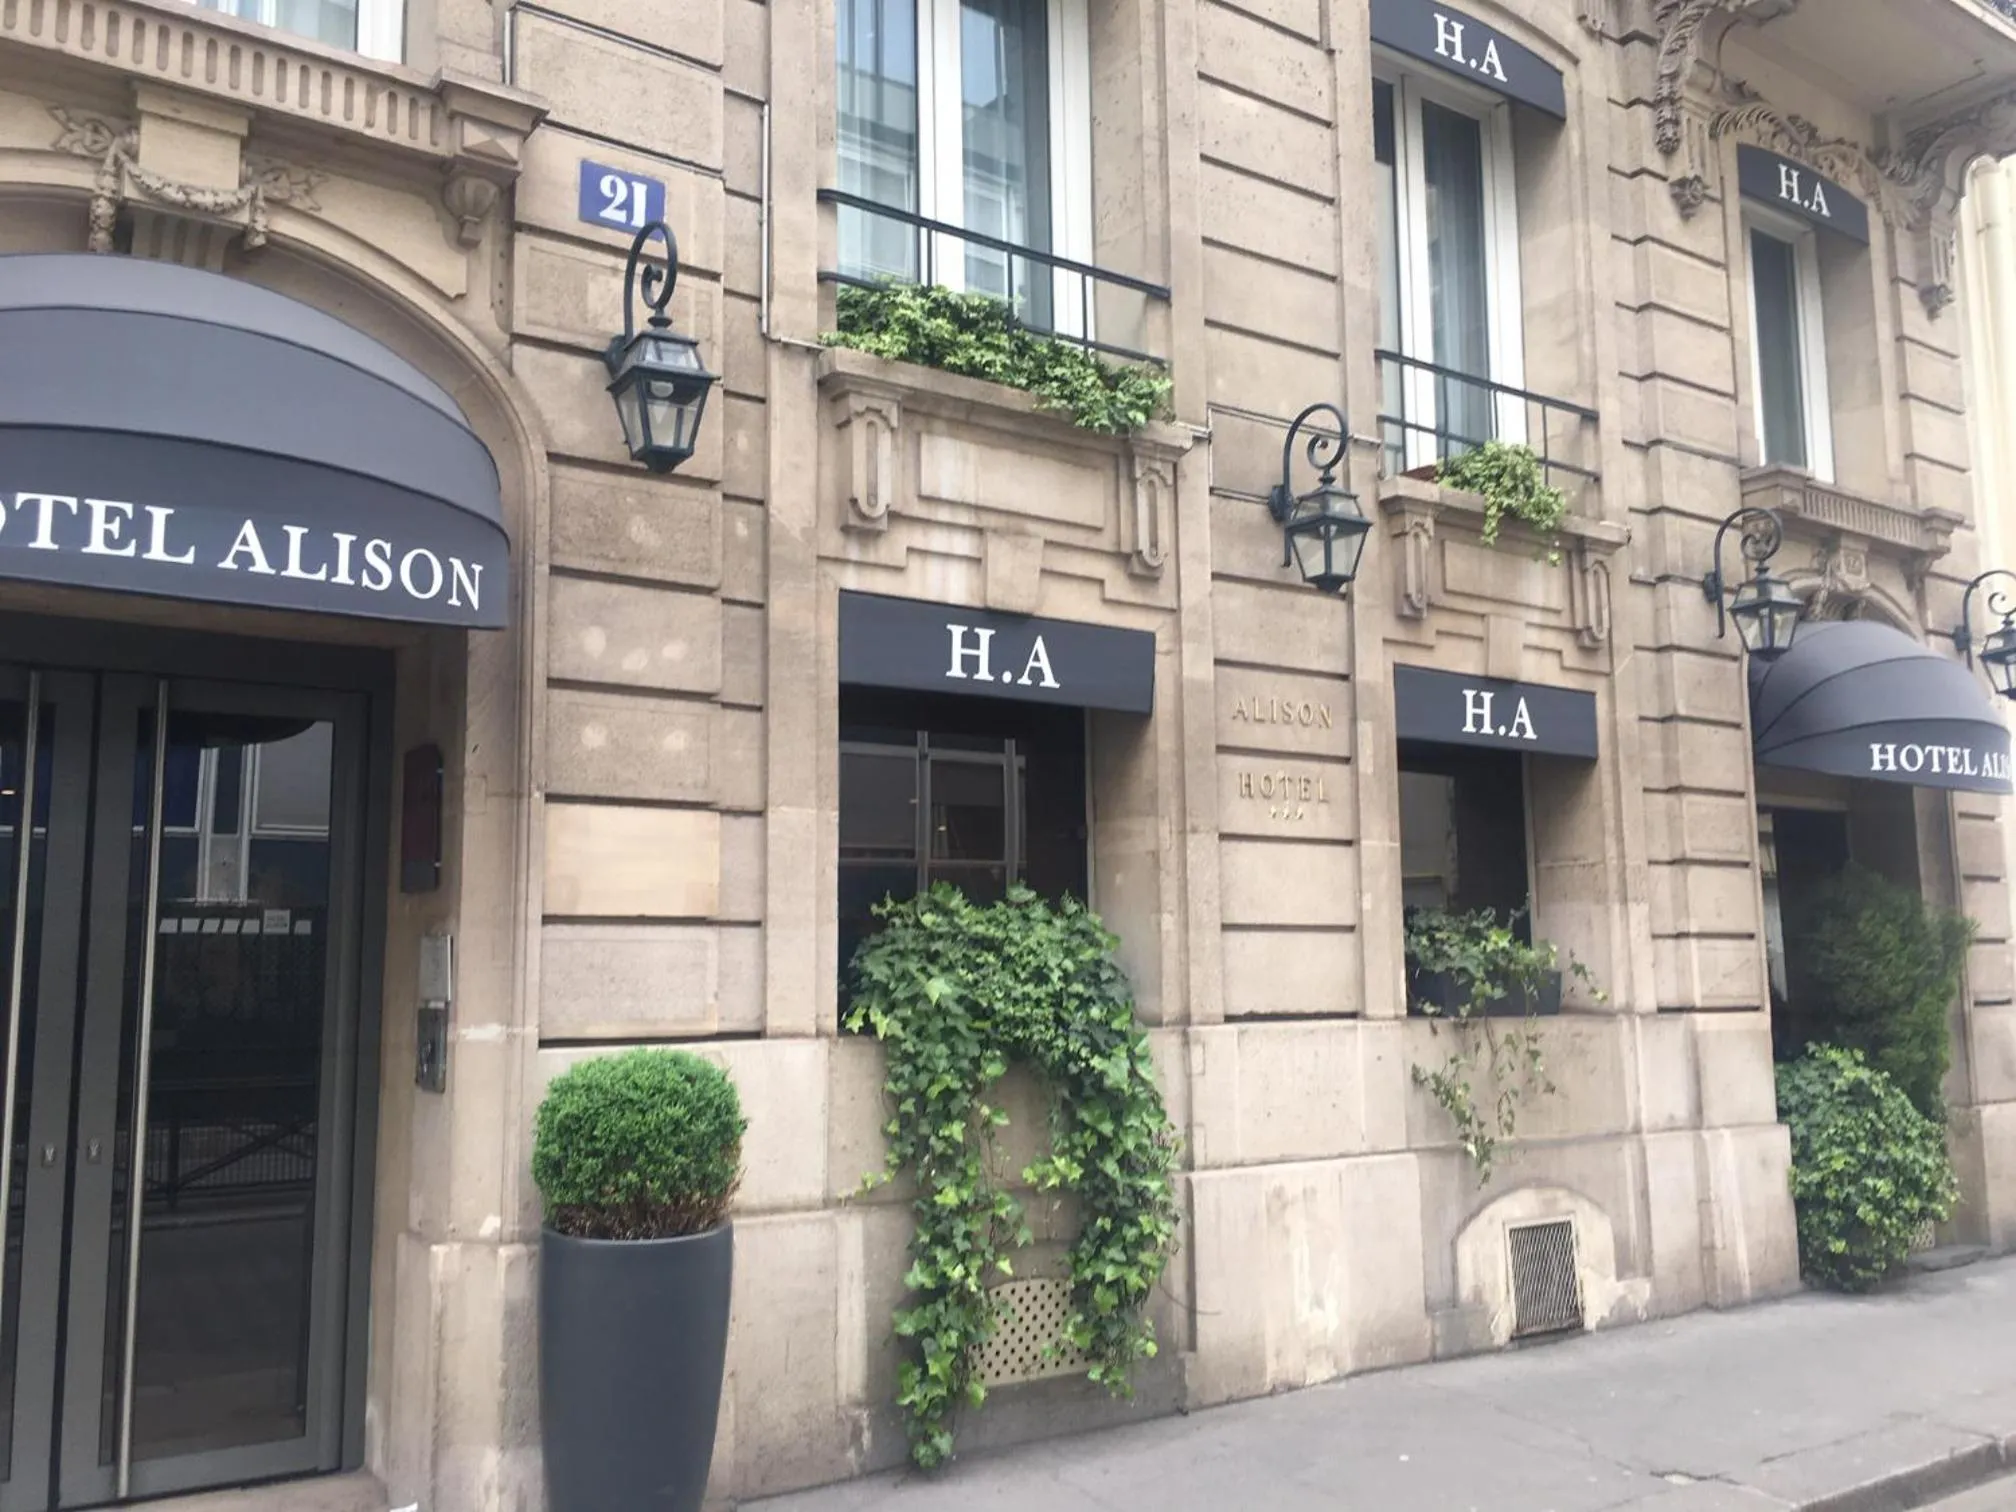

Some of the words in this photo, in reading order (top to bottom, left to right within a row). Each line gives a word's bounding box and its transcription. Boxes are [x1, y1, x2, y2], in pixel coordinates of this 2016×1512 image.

[1433, 12, 1508, 83] H.A
[599, 173, 648, 228] 21
[1778, 163, 1831, 218] H.A
[0, 491, 196, 565] TEL
[217, 518, 484, 611] ALISON
[945, 623, 1061, 689] H.A
[1231, 696, 1333, 730] ALISON
[1461, 688, 1539, 740] H.A
[1869, 742, 1979, 777] HOTEL
[1238, 771, 1330, 804] HOTEL
